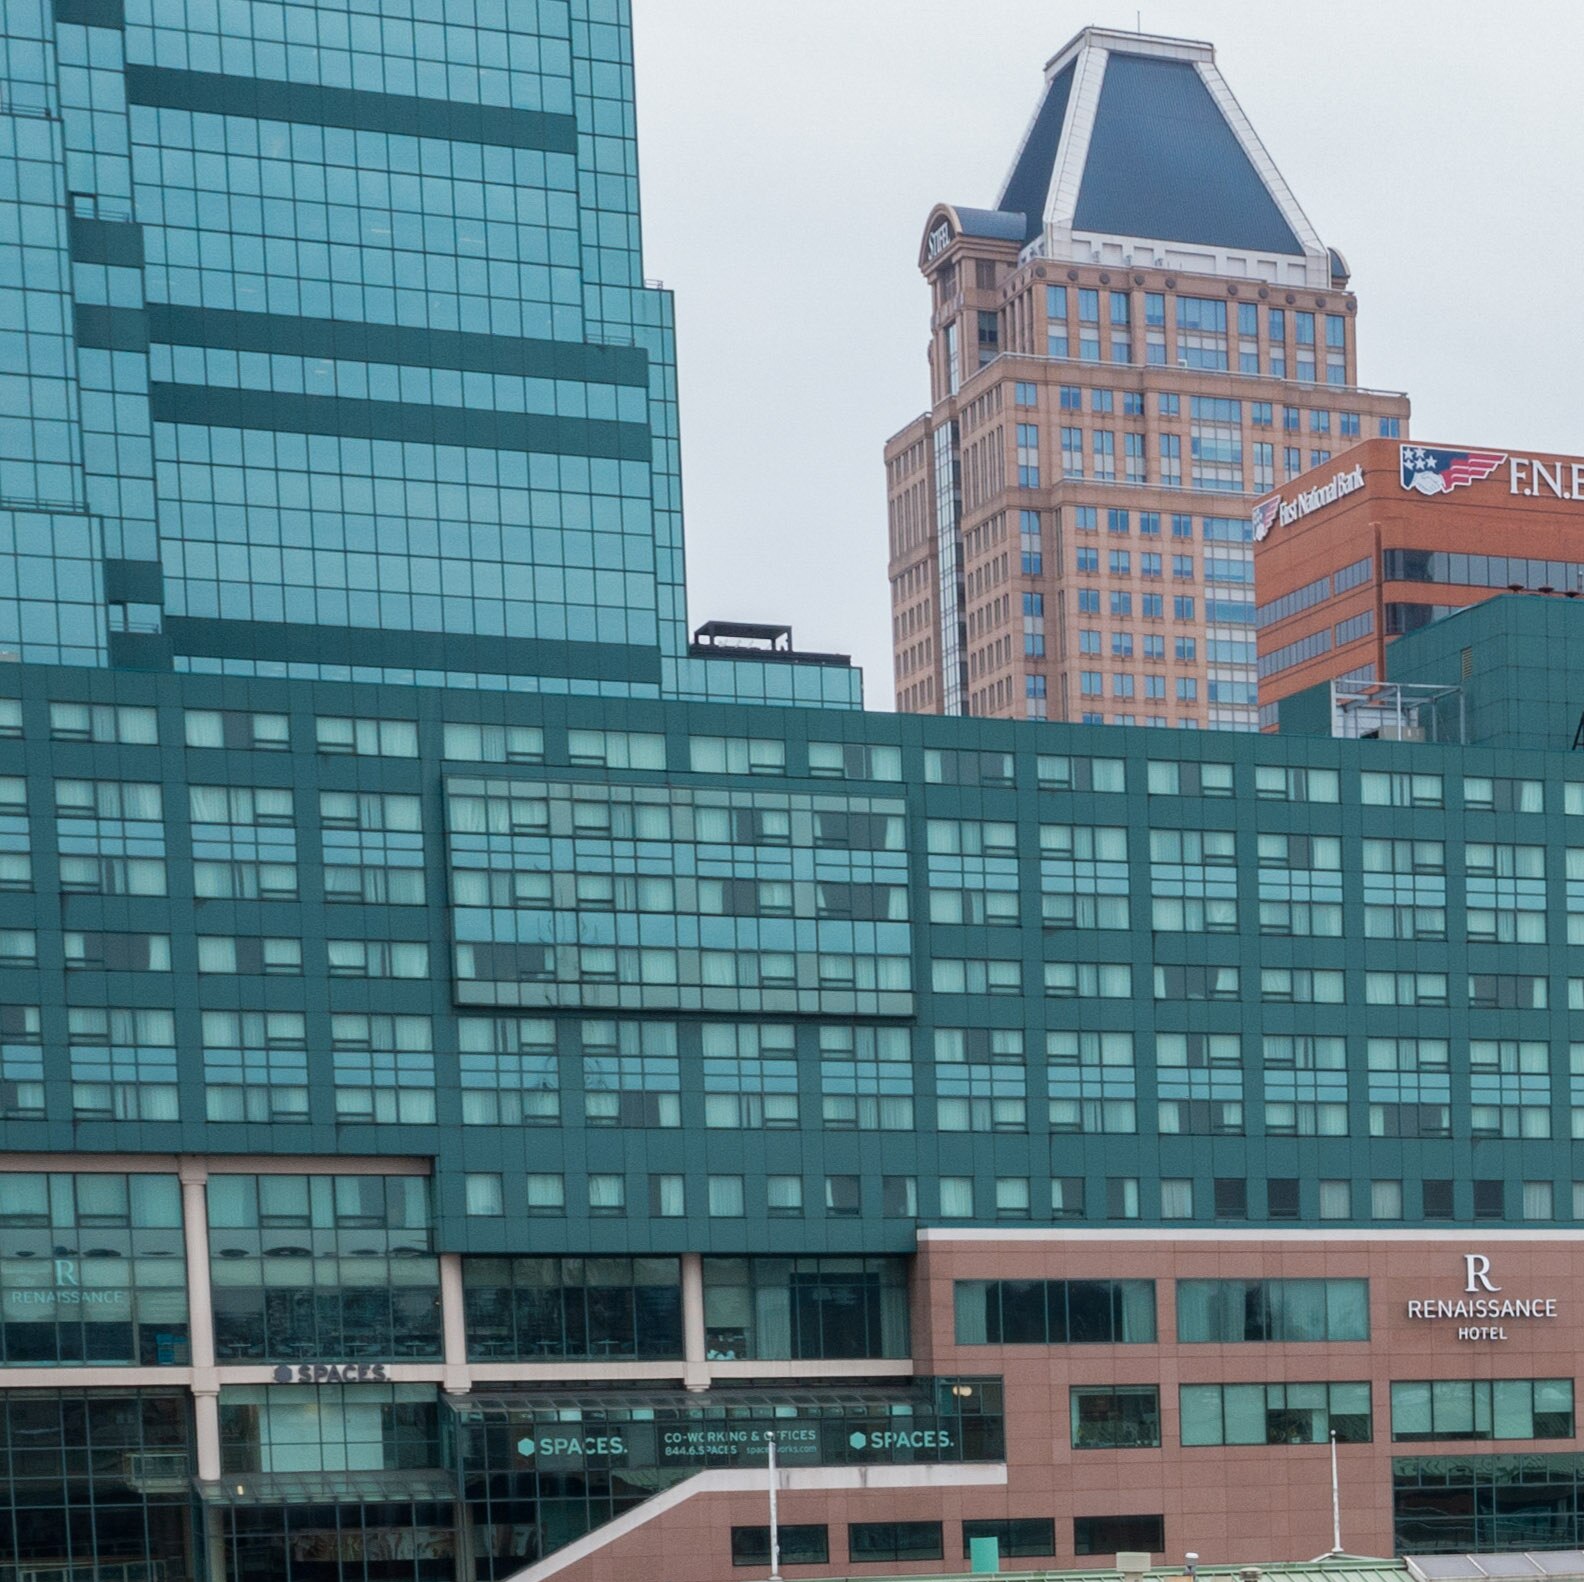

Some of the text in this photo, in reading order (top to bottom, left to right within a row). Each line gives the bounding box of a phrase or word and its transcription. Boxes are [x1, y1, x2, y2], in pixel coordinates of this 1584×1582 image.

[1279, 463, 1366, 527] First National Bank
[1464, 1254, 1502, 1292] R
[12, 1291, 124, 1304] RENAISSANCE
[1408, 1299, 1558, 1319] RENAISSANCE
[1458, 1327, 1508, 1340] HOTEL
[751, 1431, 760, 1442] &
